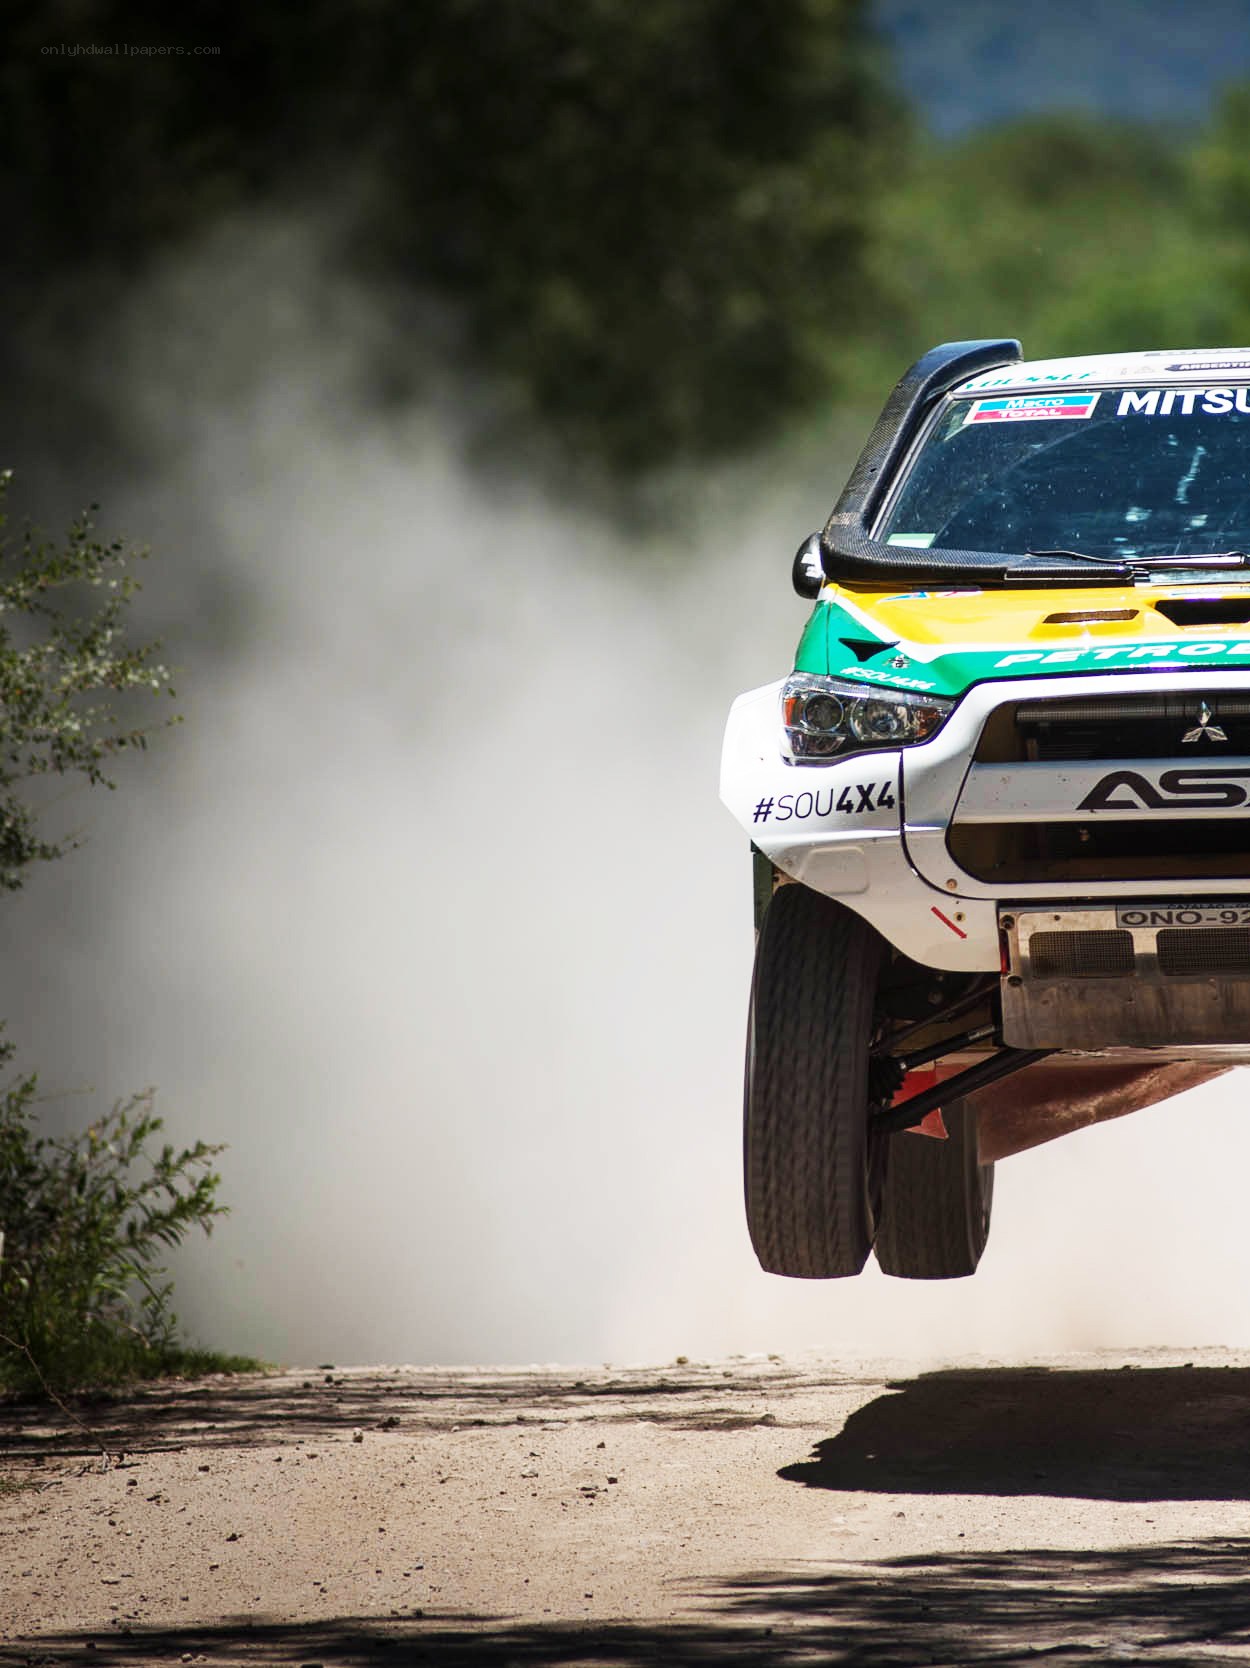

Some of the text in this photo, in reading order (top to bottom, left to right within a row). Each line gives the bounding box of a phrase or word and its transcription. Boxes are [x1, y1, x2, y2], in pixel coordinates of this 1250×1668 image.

[1005, 397, 1065, 409] Macro
[999, 408, 1062, 418] TOTAL
[752, 780, 896, 823] #SOU4X4
